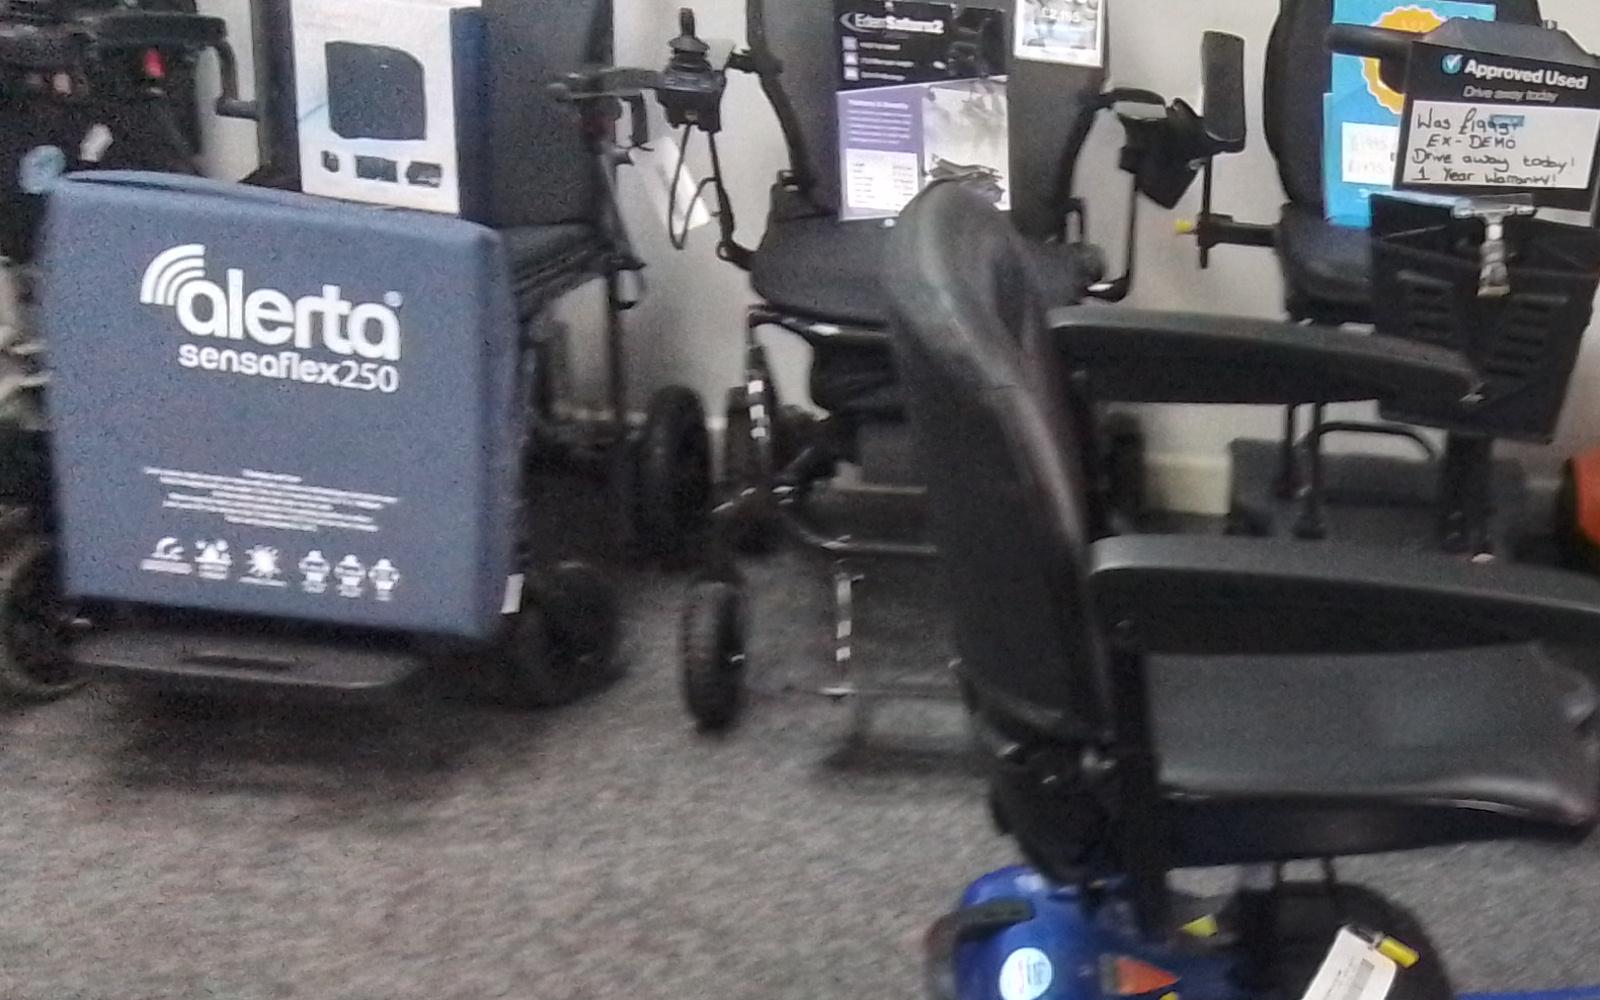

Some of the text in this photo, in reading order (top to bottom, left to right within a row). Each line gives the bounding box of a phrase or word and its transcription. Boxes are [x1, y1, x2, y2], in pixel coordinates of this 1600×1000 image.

[1464, 59, 1589, 90] Approved Used
[1462, 85, 1493, 99] Drive
[1417, 107, 1451, 130] Was
[1411, 147, 1452, 165] Drive
[1462, 154, 1509, 173] away
[1443, 167, 1473, 182] Year
[175, 267, 402, 361] alerta
[177, 343, 401, 393] sensaflex250
